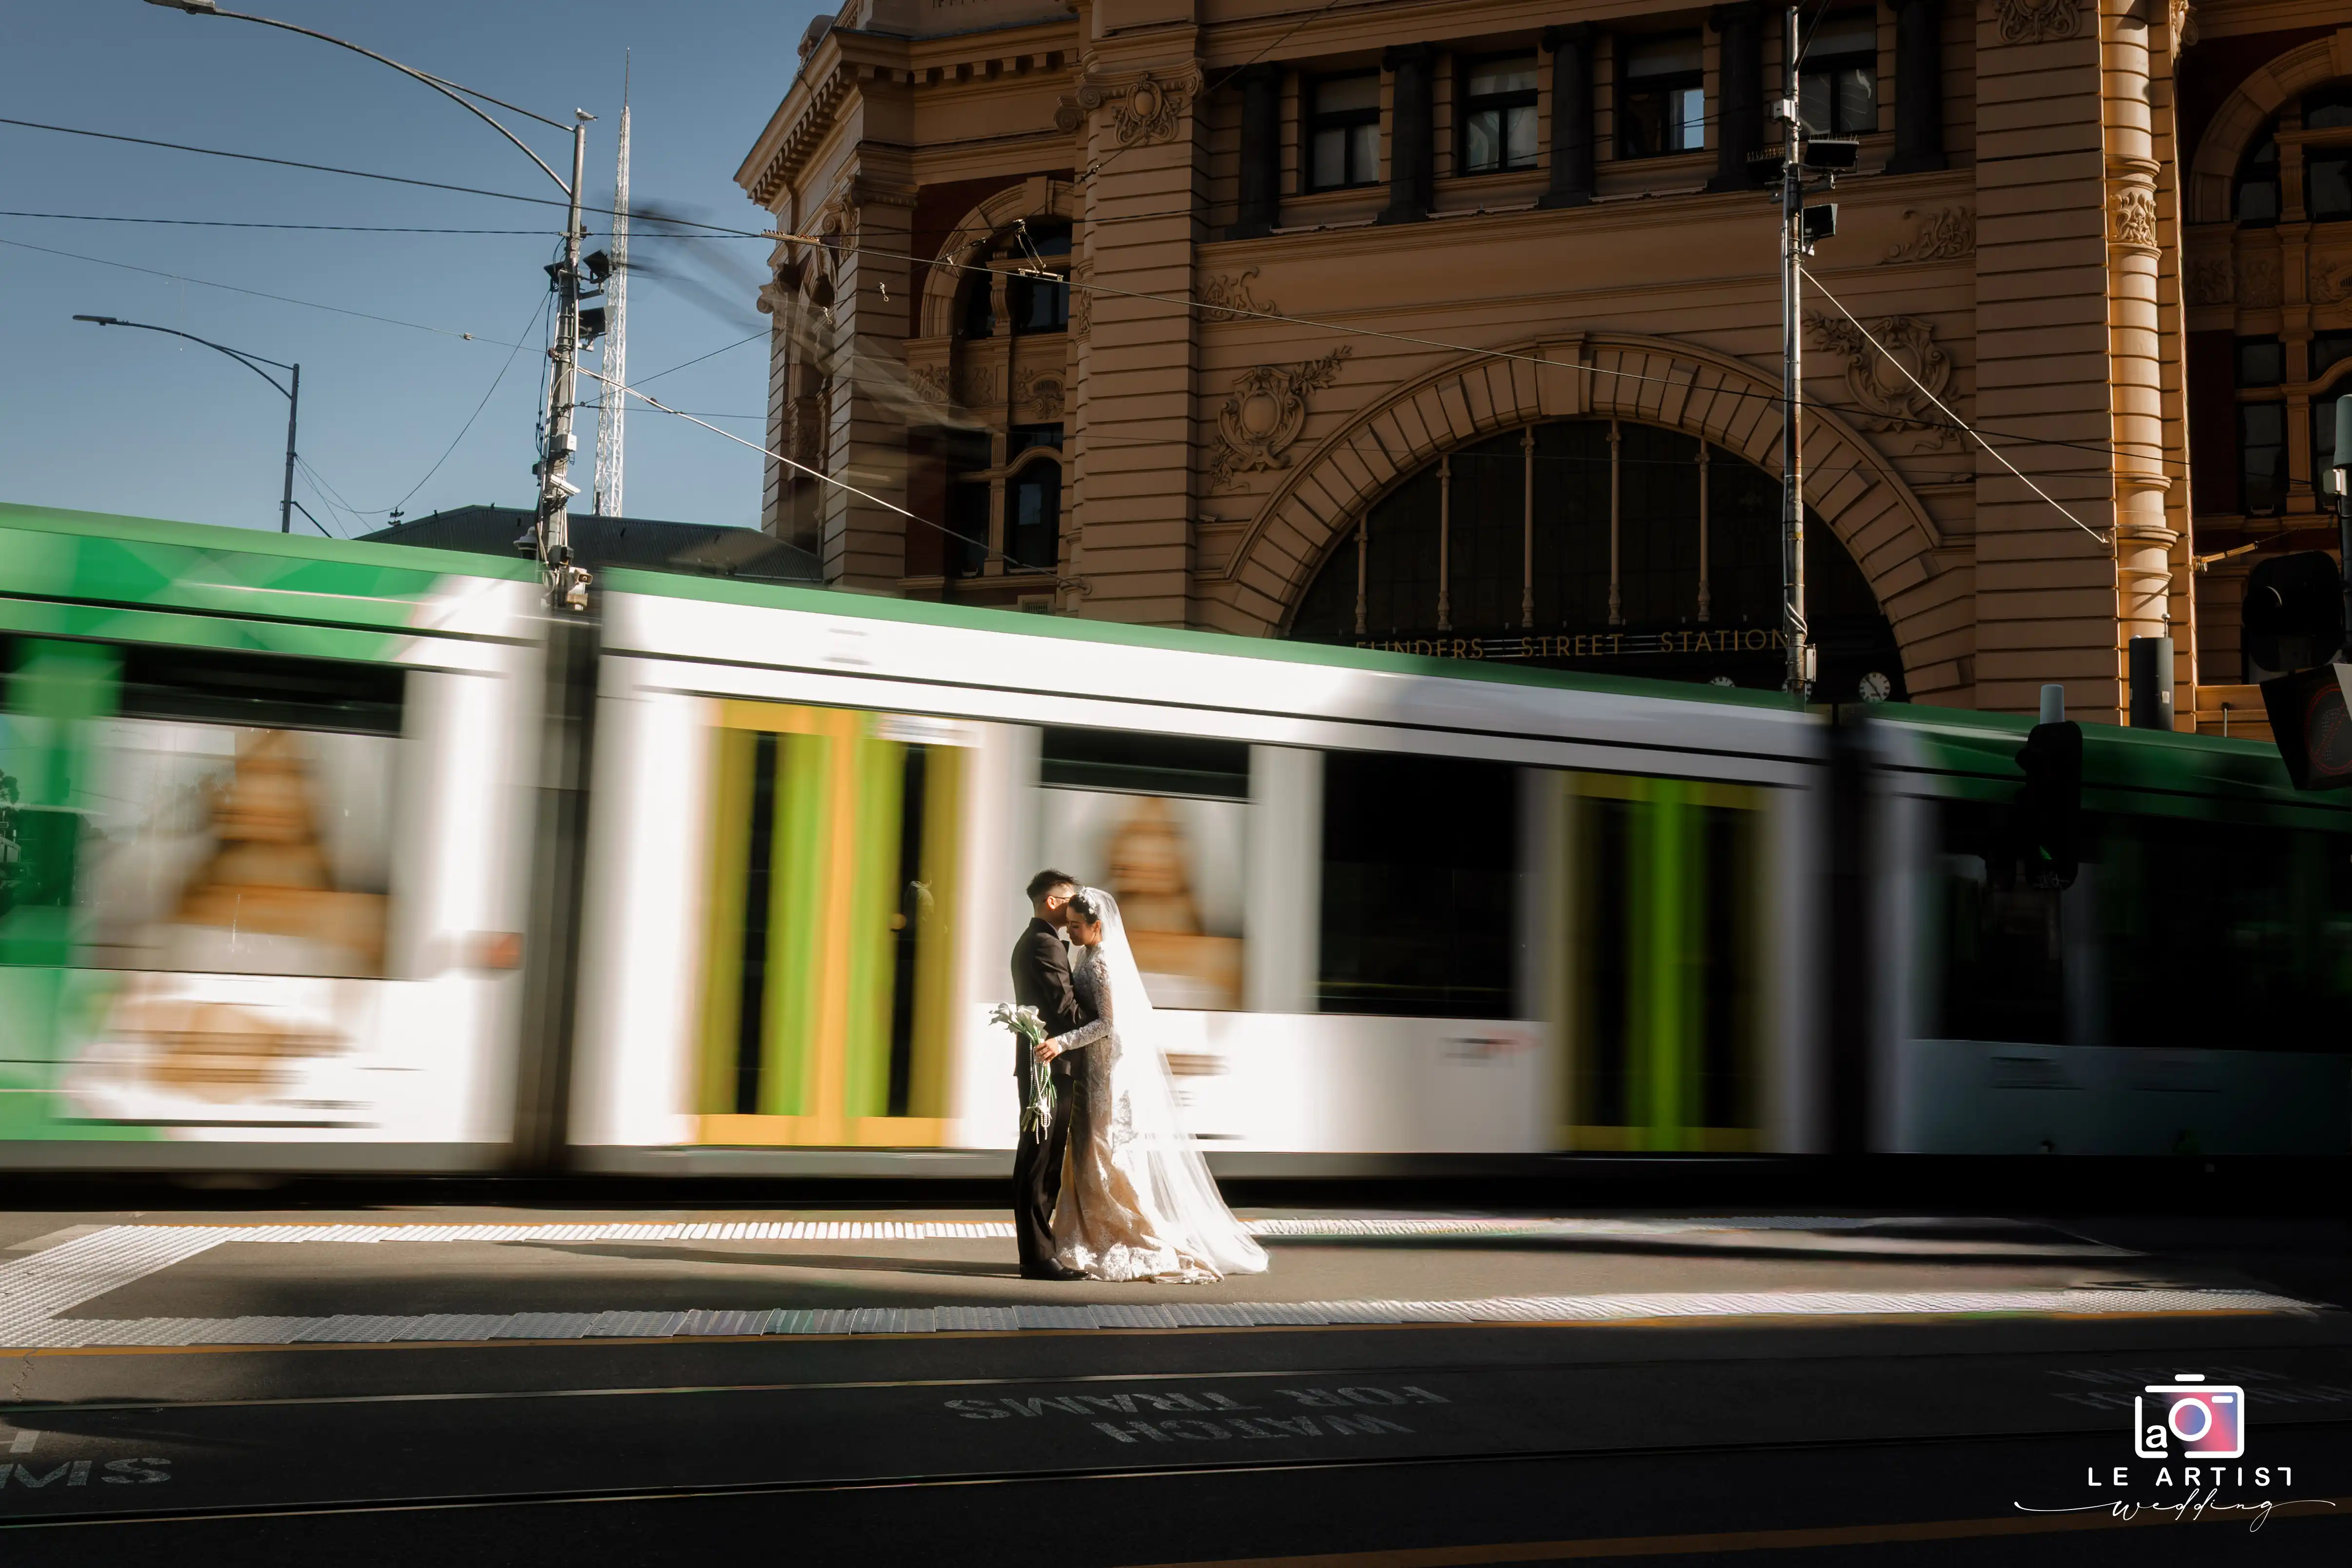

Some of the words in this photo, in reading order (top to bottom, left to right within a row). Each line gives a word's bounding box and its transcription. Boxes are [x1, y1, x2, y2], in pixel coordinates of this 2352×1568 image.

[1521, 634, 1624, 657] STREET
[1661, 628, 1787, 653] STATION
[944, 1392, 1262, 1419] TRAMS
[1274, 1386, 1453, 1407] FOR
[1091, 1414, 1417, 1442] WATCH
